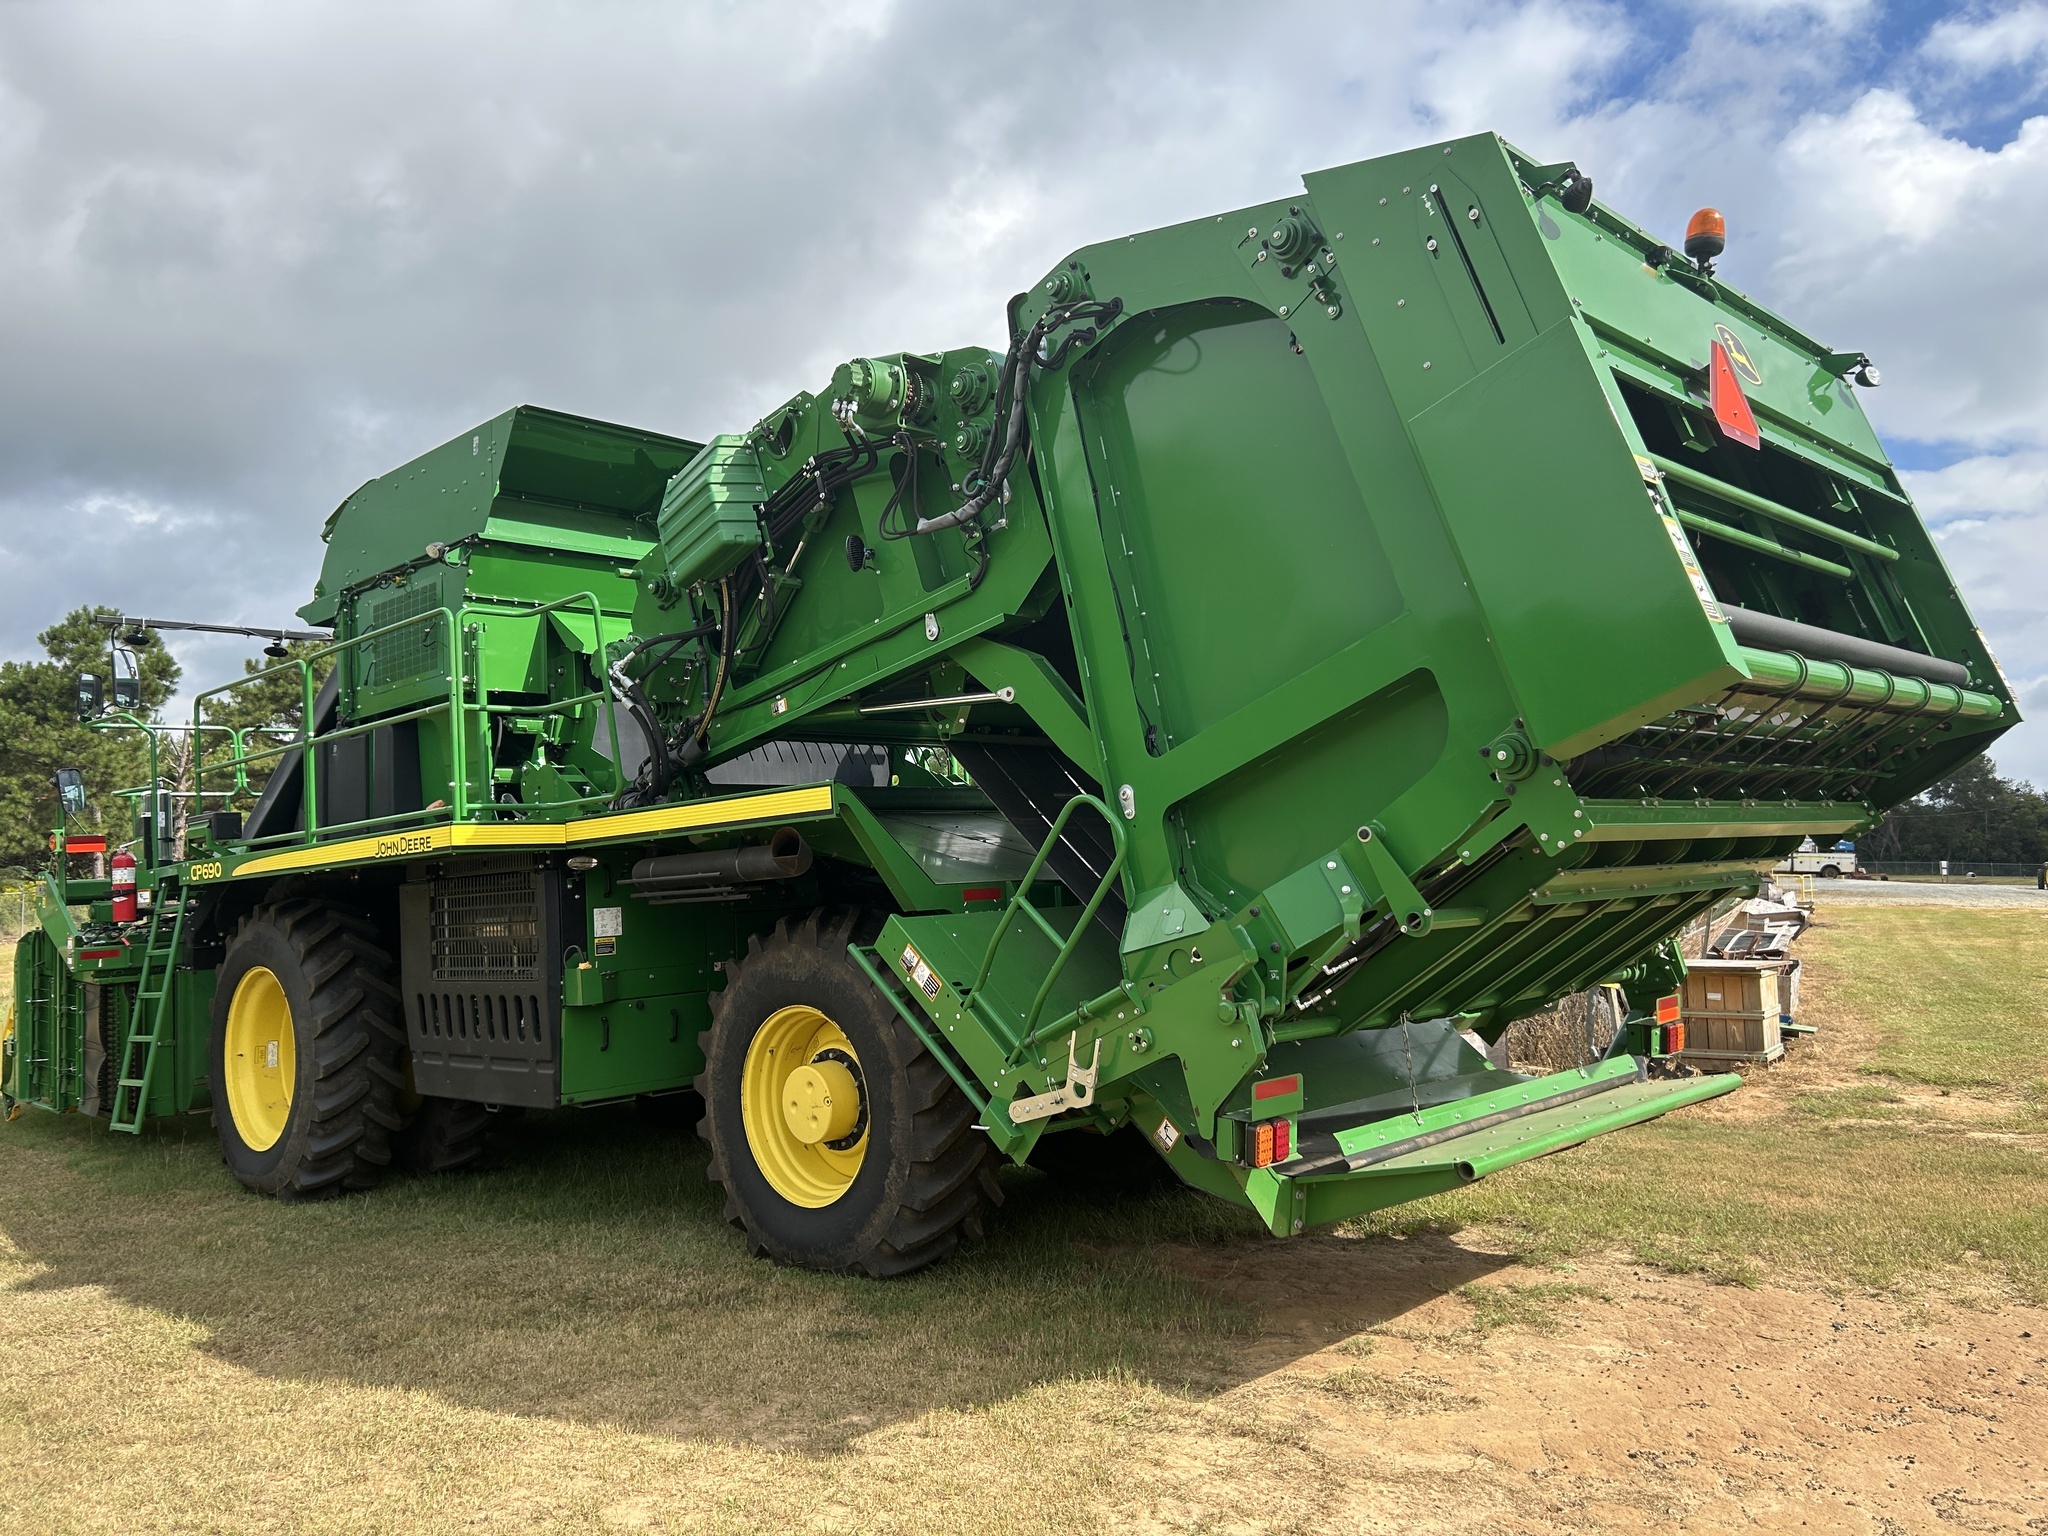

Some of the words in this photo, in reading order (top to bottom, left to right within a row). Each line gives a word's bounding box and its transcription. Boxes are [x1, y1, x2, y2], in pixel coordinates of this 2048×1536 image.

[375, 840, 399, 856] JOHN
[400, 836, 432, 852] DEERE
[190, 861, 222, 881] CP690
